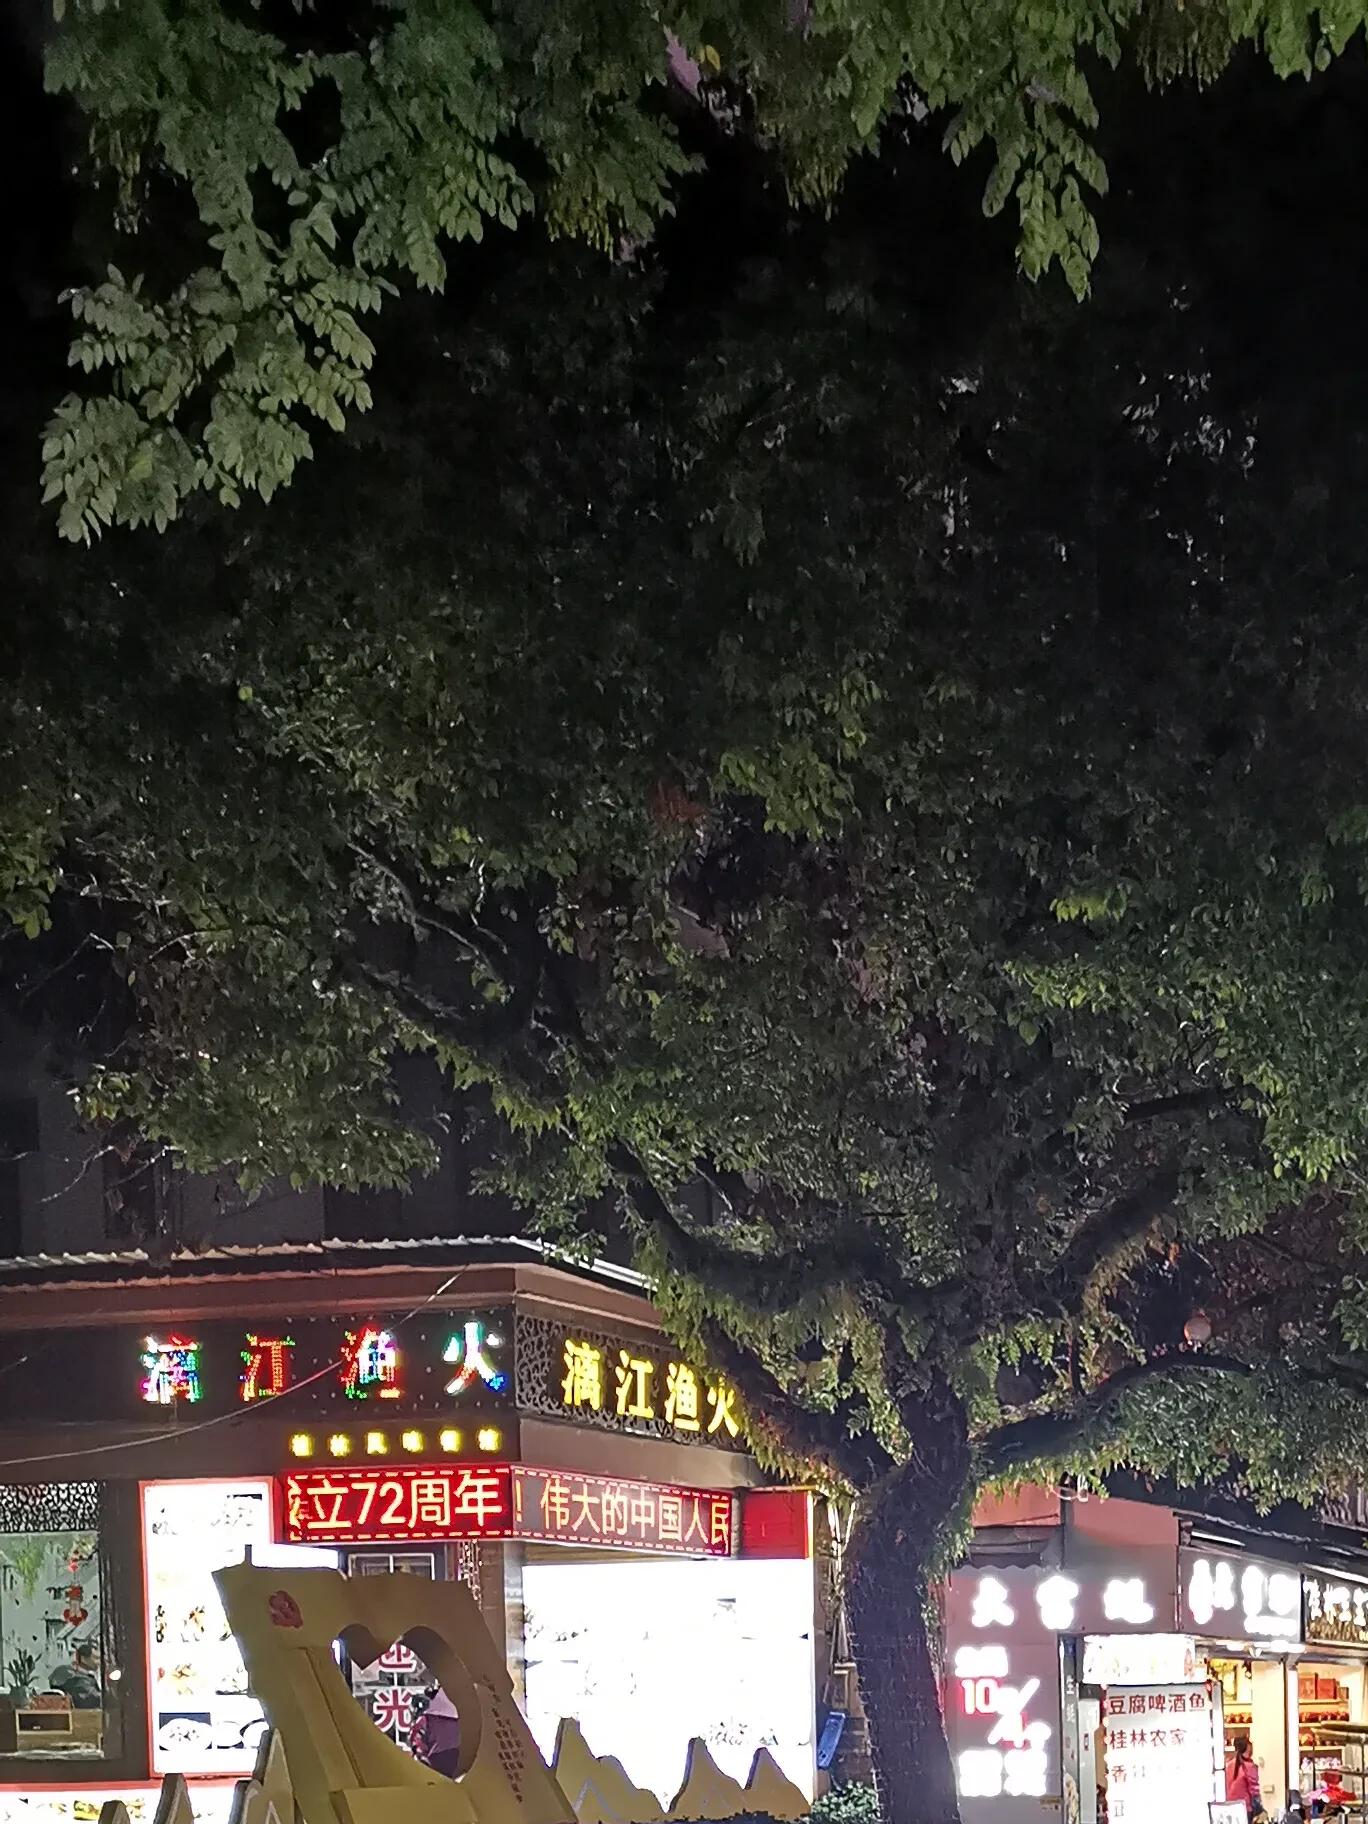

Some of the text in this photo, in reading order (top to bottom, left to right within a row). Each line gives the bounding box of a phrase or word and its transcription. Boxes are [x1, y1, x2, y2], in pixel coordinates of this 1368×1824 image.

[139, 1321, 504, 1403] 漓江渔火
[561, 1339, 740, 1438] 漓江渔火
[1108, 1692, 1206, 1716] 豆腐啤酒鱼
